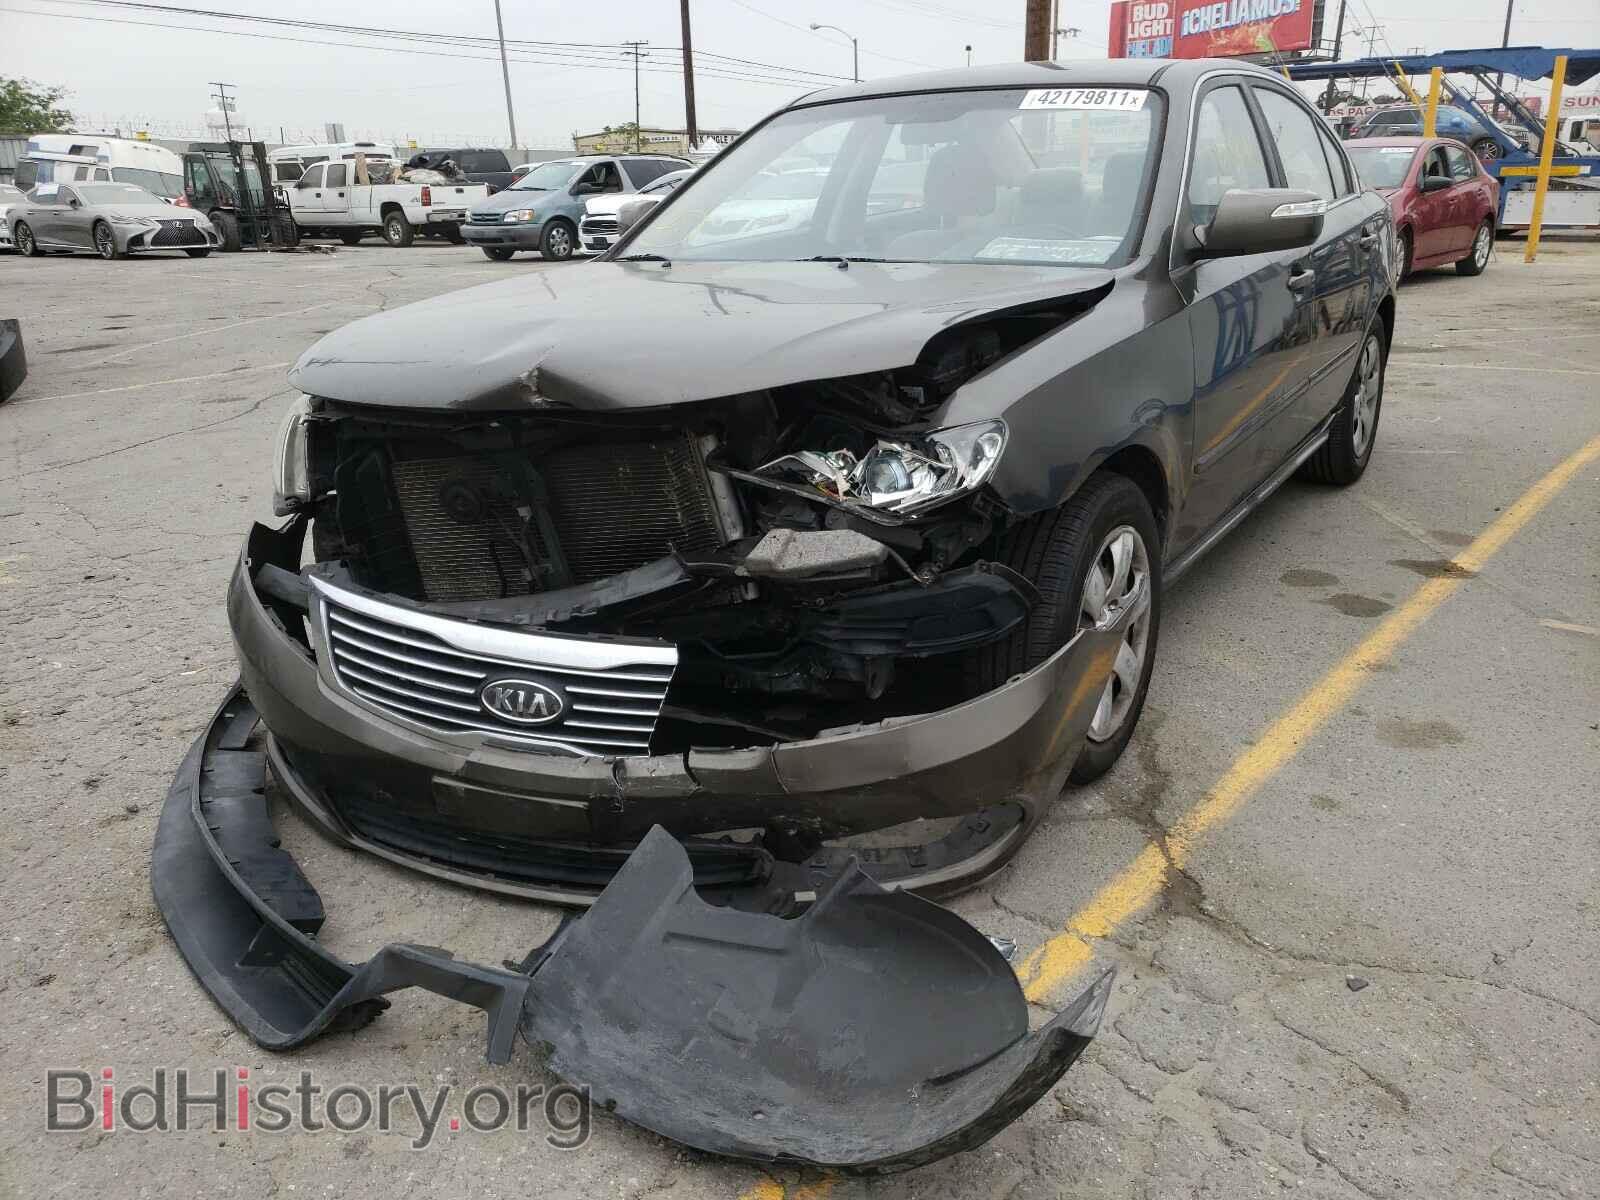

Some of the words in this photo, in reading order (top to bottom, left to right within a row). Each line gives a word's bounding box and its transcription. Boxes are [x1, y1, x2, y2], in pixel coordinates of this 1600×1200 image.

[1132, 3, 1169, 22] BUD
[1128, 18, 1175, 39] LIGHT
[494, 687, 549, 716] KIA
